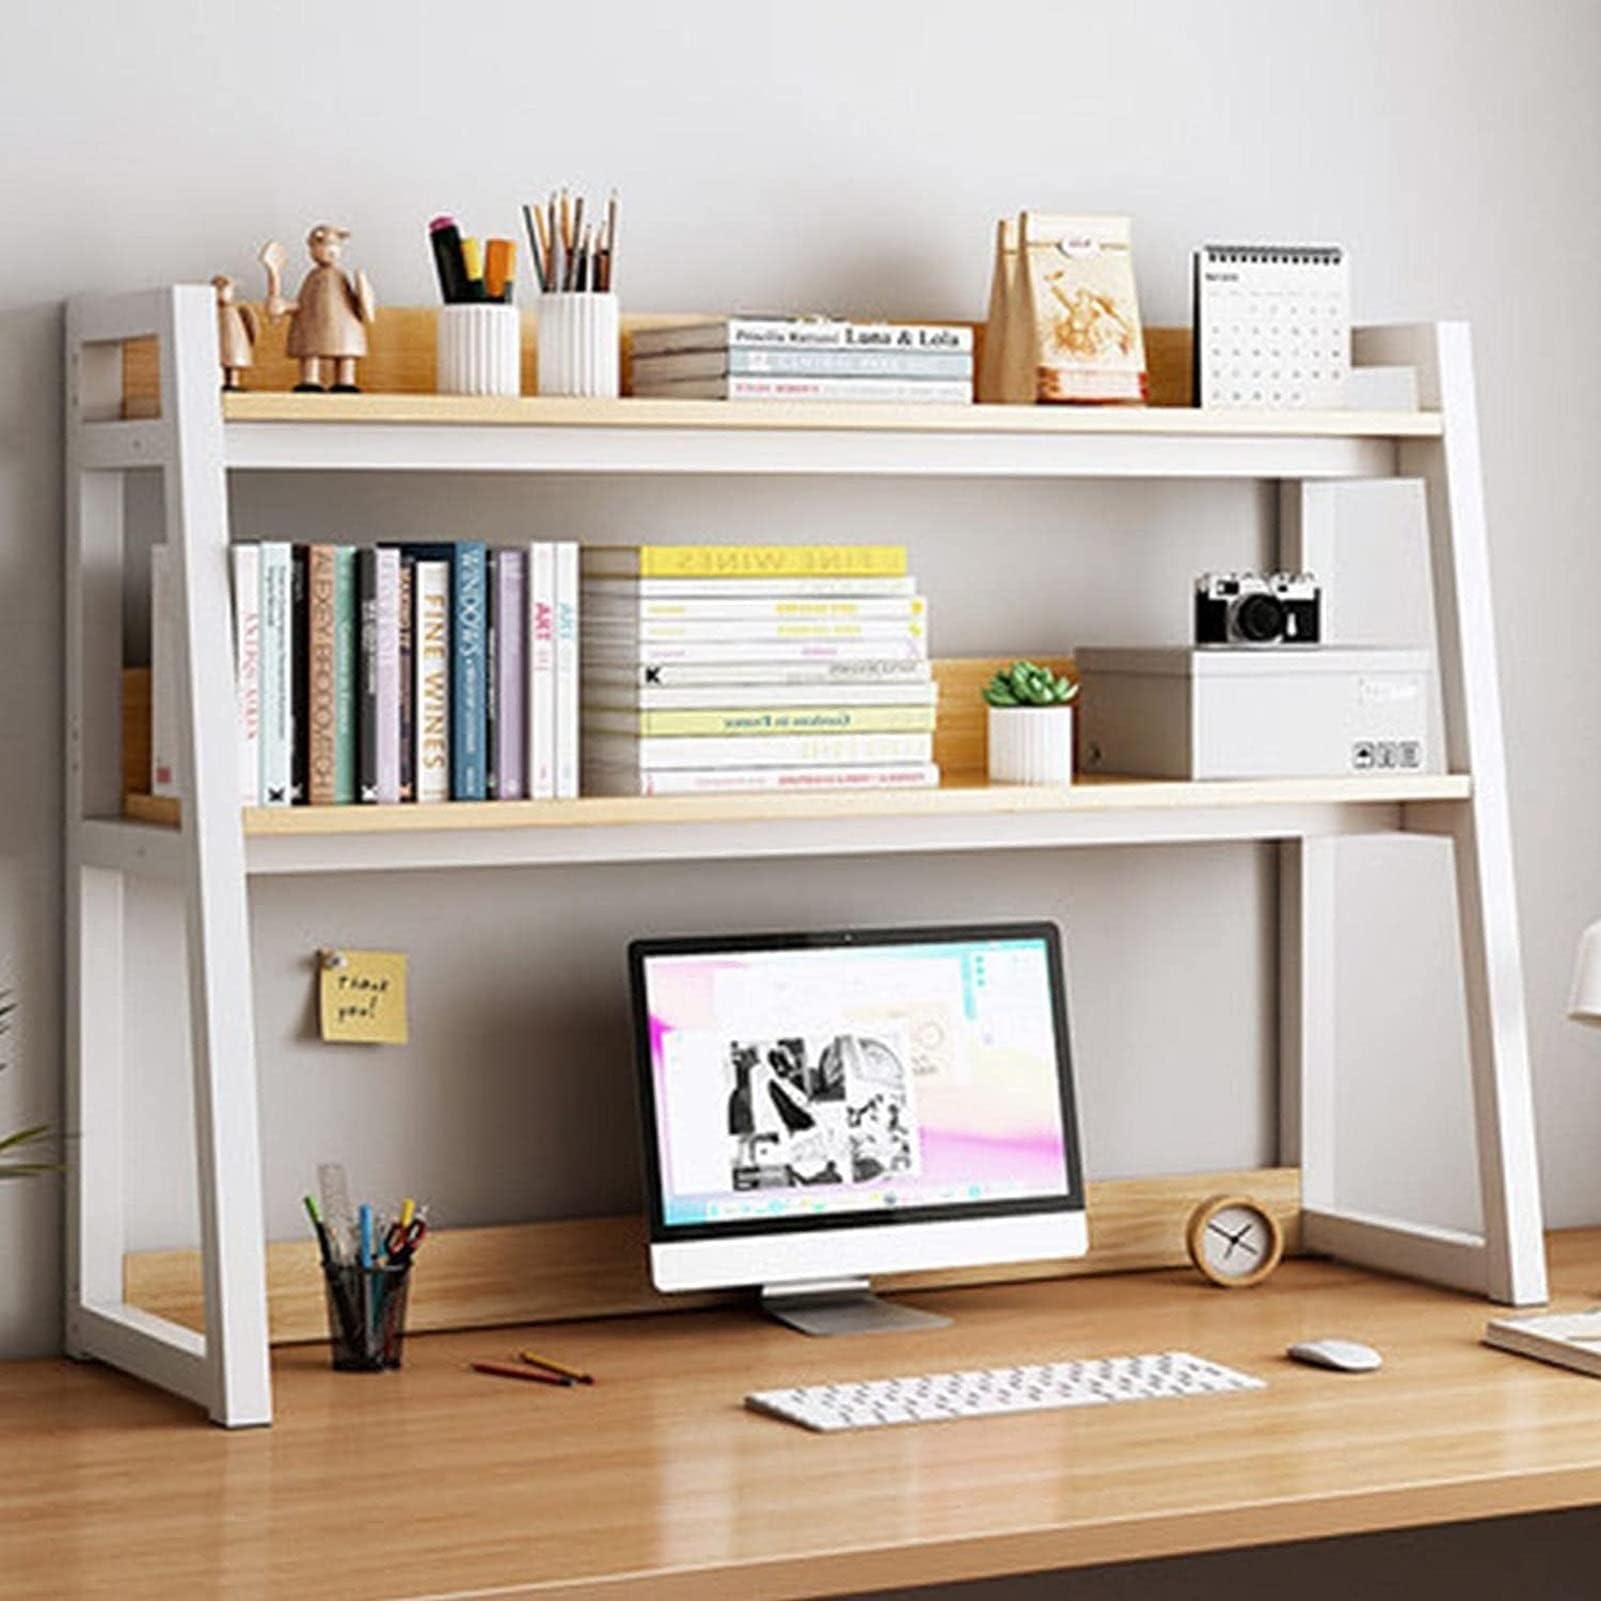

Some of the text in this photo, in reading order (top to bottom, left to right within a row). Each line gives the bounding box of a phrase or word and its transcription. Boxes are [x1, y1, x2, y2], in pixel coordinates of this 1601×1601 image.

[845, 329, 891, 345] Luna
[897, 331, 912, 346] &
[919, 331, 959, 347] Lola
[459, 549, 481, 656] WINDOWS
[423, 594, 445, 769] FINE WINES
